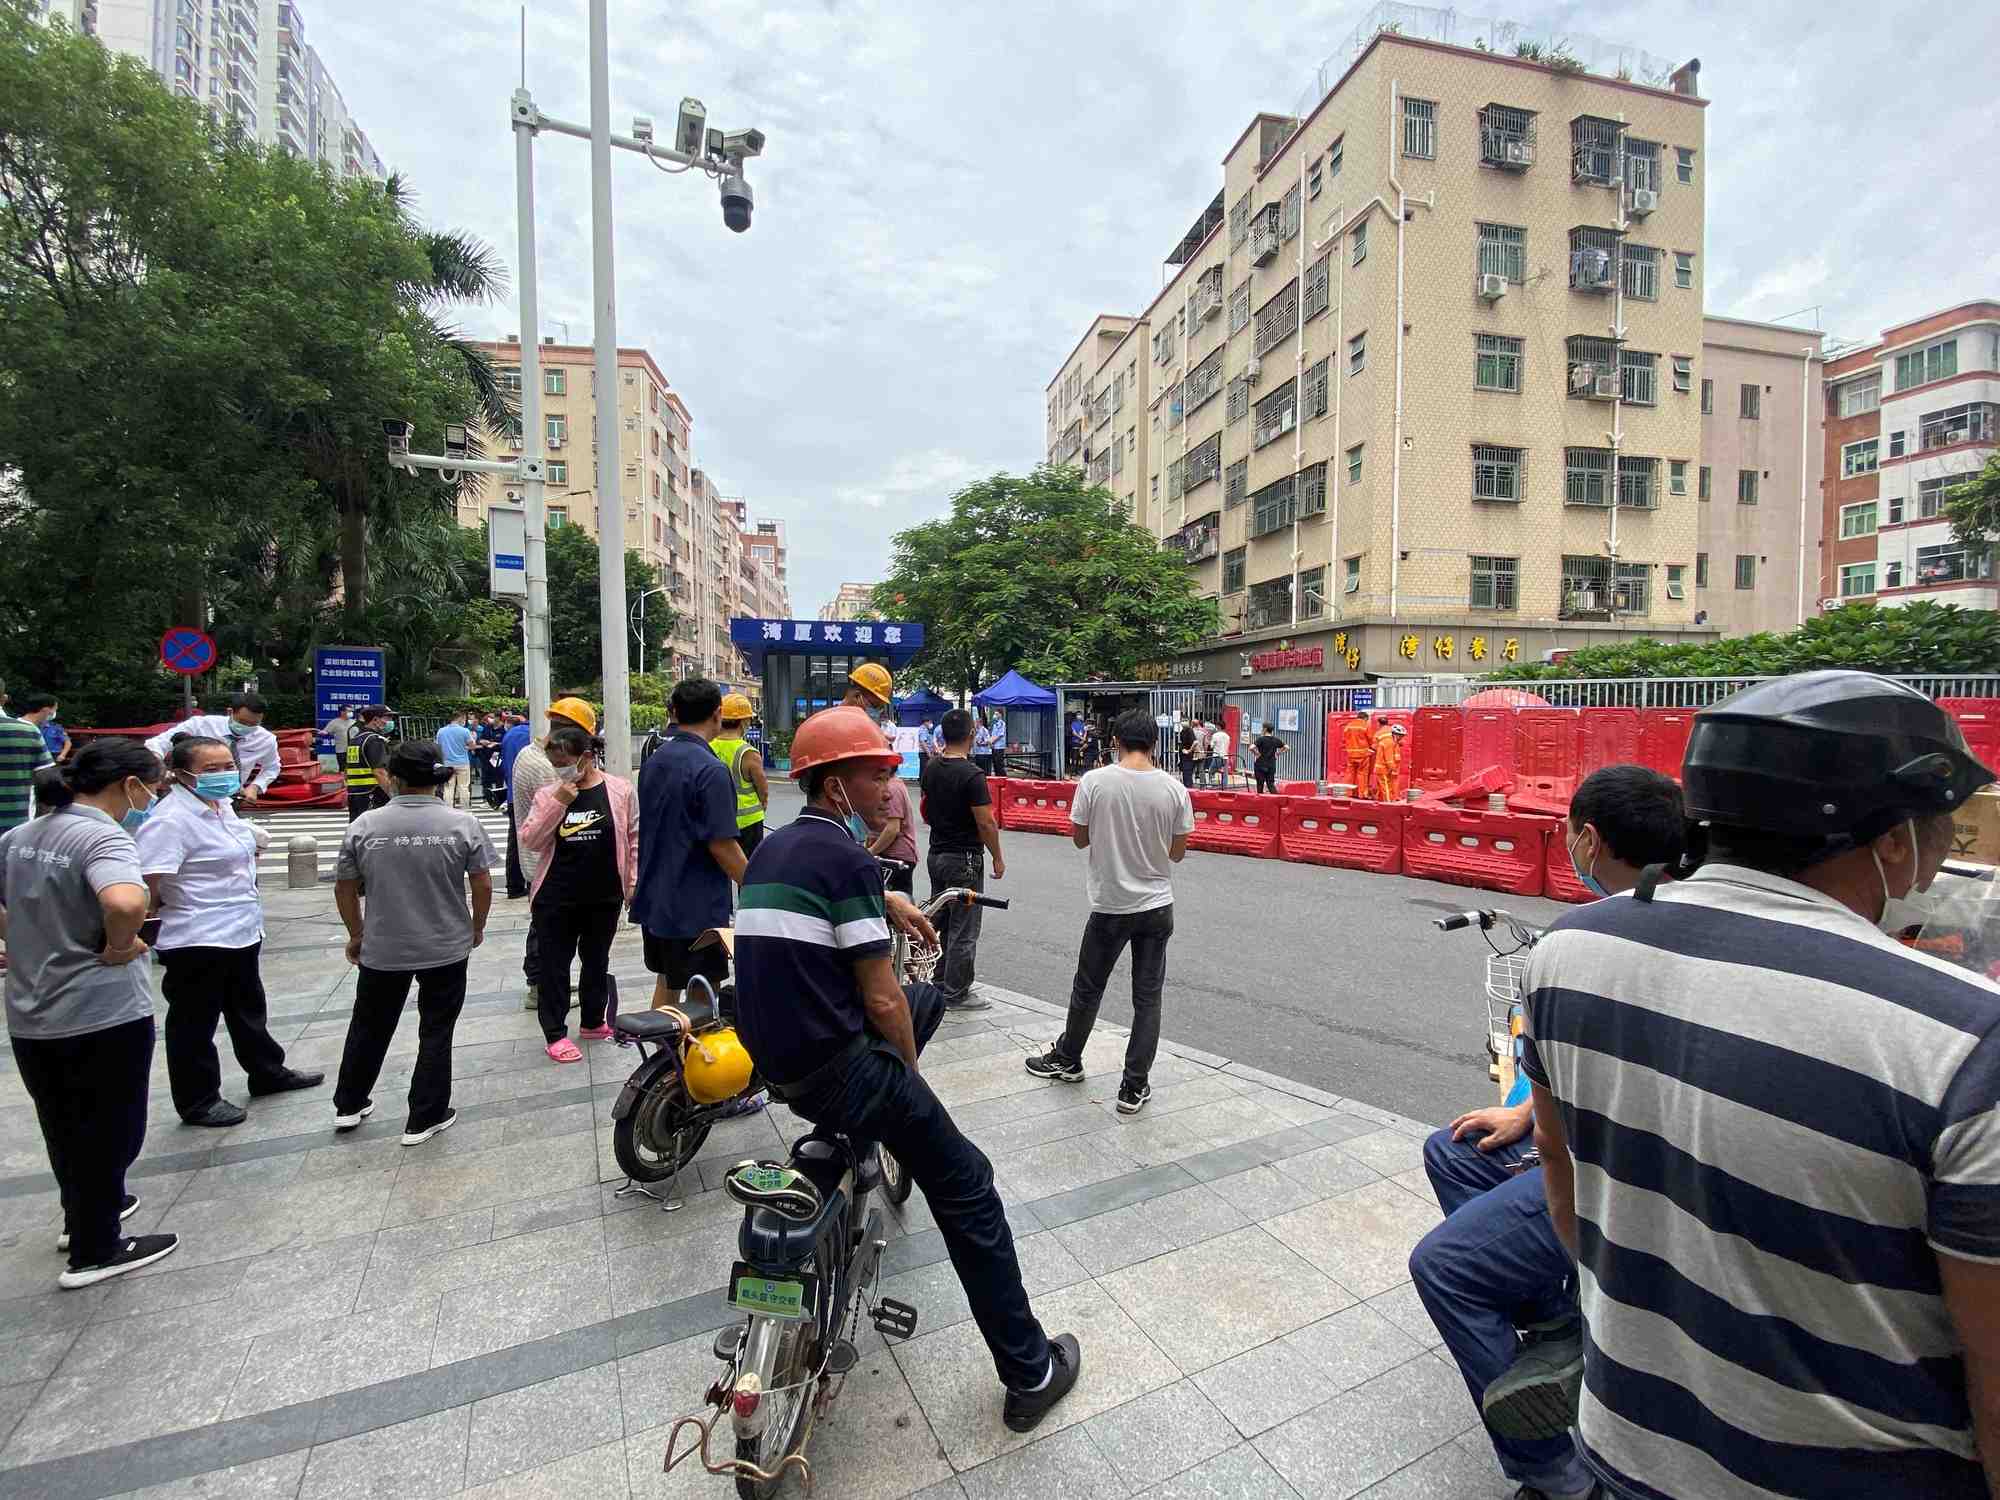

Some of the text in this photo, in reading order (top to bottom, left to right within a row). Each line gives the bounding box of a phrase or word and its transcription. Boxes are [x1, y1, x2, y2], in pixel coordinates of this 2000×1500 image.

[761, 621, 902, 644] 湾厦欢迎您
[1400, 633, 1520, 661] 湾仔餐厅
[565, 810, 600, 825] NIKE
